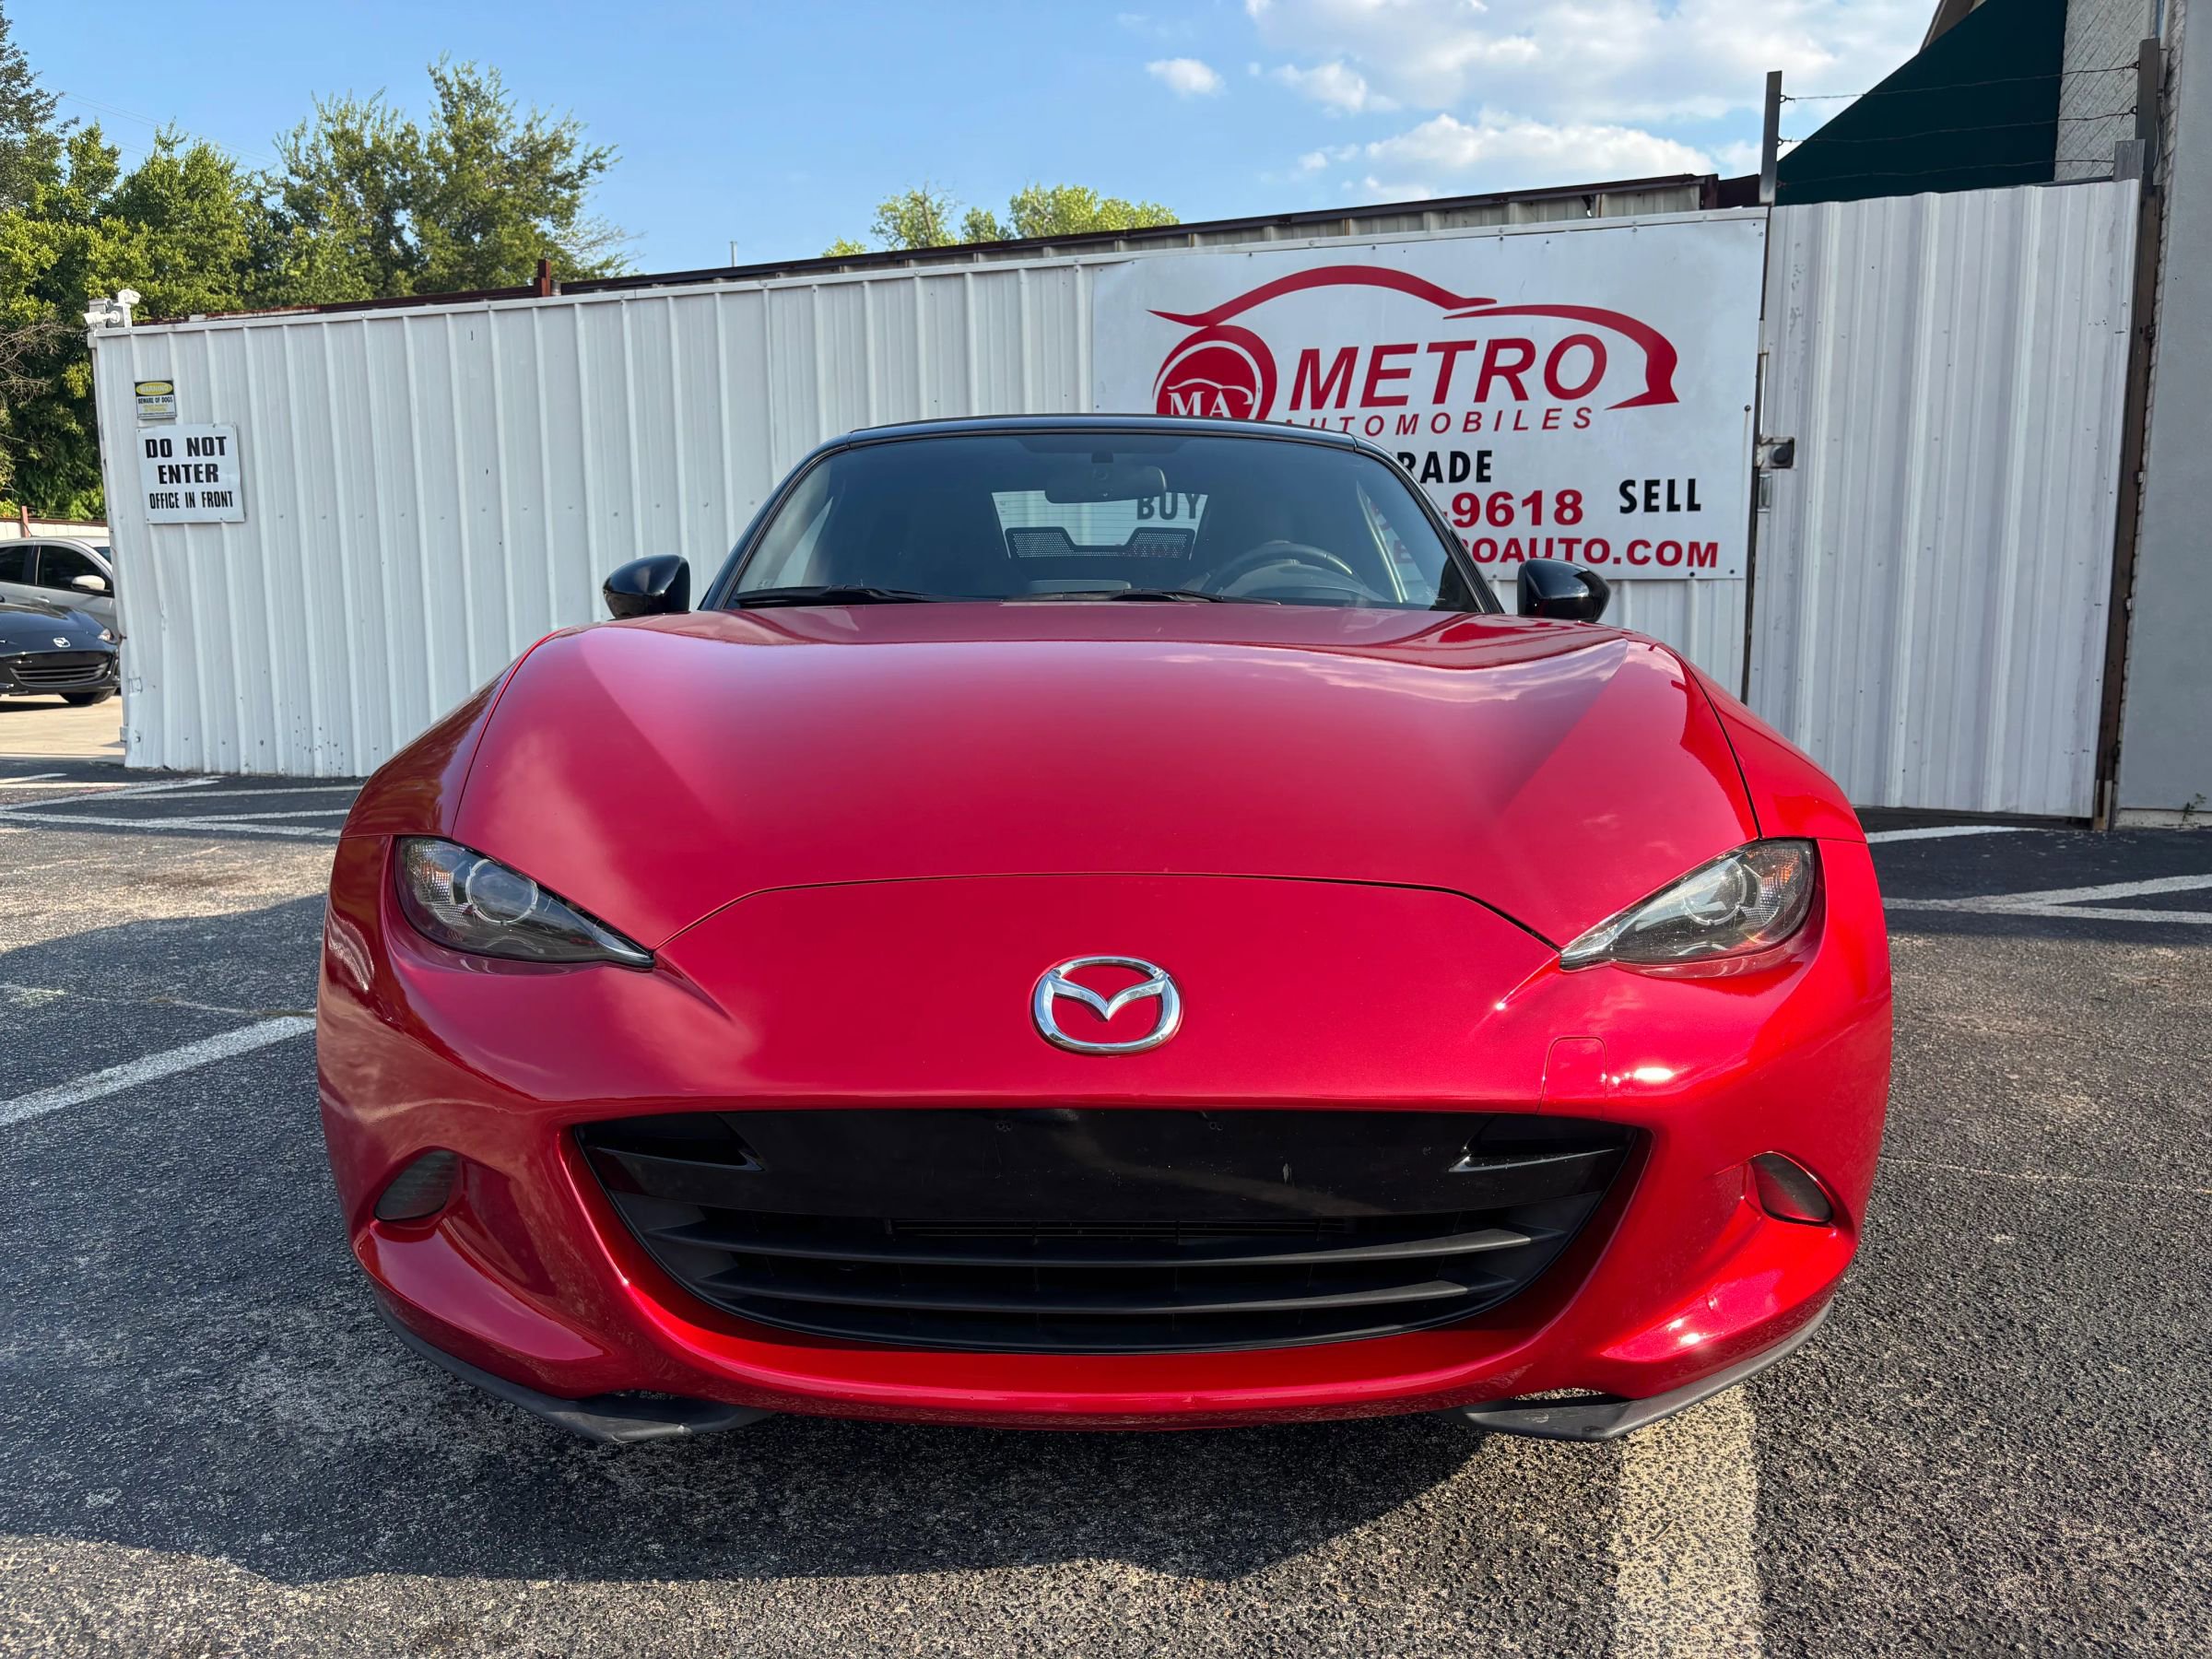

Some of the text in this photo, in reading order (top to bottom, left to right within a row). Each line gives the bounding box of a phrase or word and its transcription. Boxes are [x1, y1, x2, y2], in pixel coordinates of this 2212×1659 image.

[1288, 333, 1607, 411] METRO
[1168, 390, 1232, 418] MA
[1286, 406, 1593, 437] TOMOBILES
[145, 436, 227, 458] DO NOT
[158, 463, 219, 485] ENTER
[1389, 450, 1493, 484] RADE
[148, 490, 233, 509] OFFICE IN FRONT
[1136, 491, 1201, 521] BUY
[1618, 477, 1702, 514] SELL
[1461, 537, 1719, 568] OAUTO.COM
